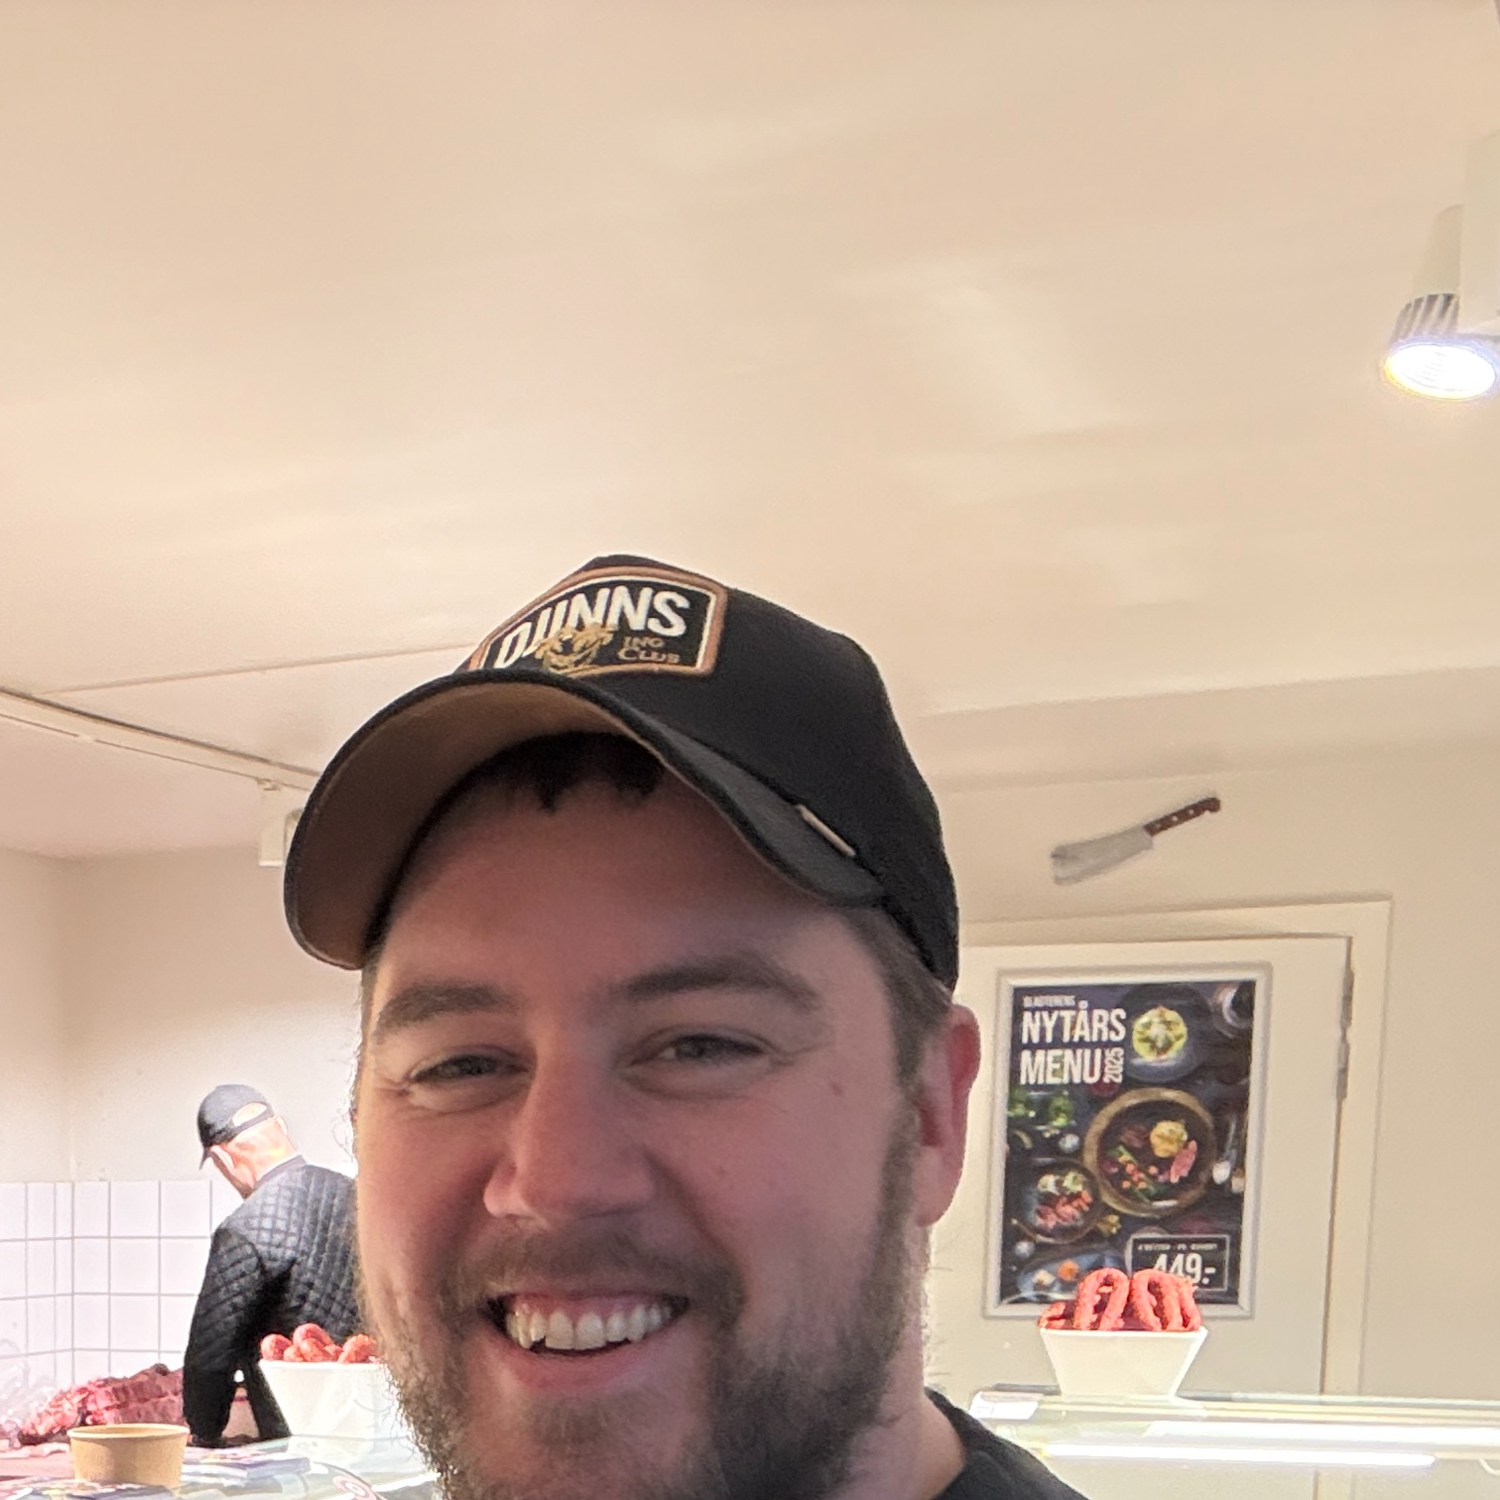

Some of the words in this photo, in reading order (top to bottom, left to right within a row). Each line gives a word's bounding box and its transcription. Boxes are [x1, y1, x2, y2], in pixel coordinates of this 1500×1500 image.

[1021, 1000, 1127, 1044] NYTÅRS
[1020, 1048, 1102, 1085] MENU
[1102, 1046, 1125, 1083] 2025
